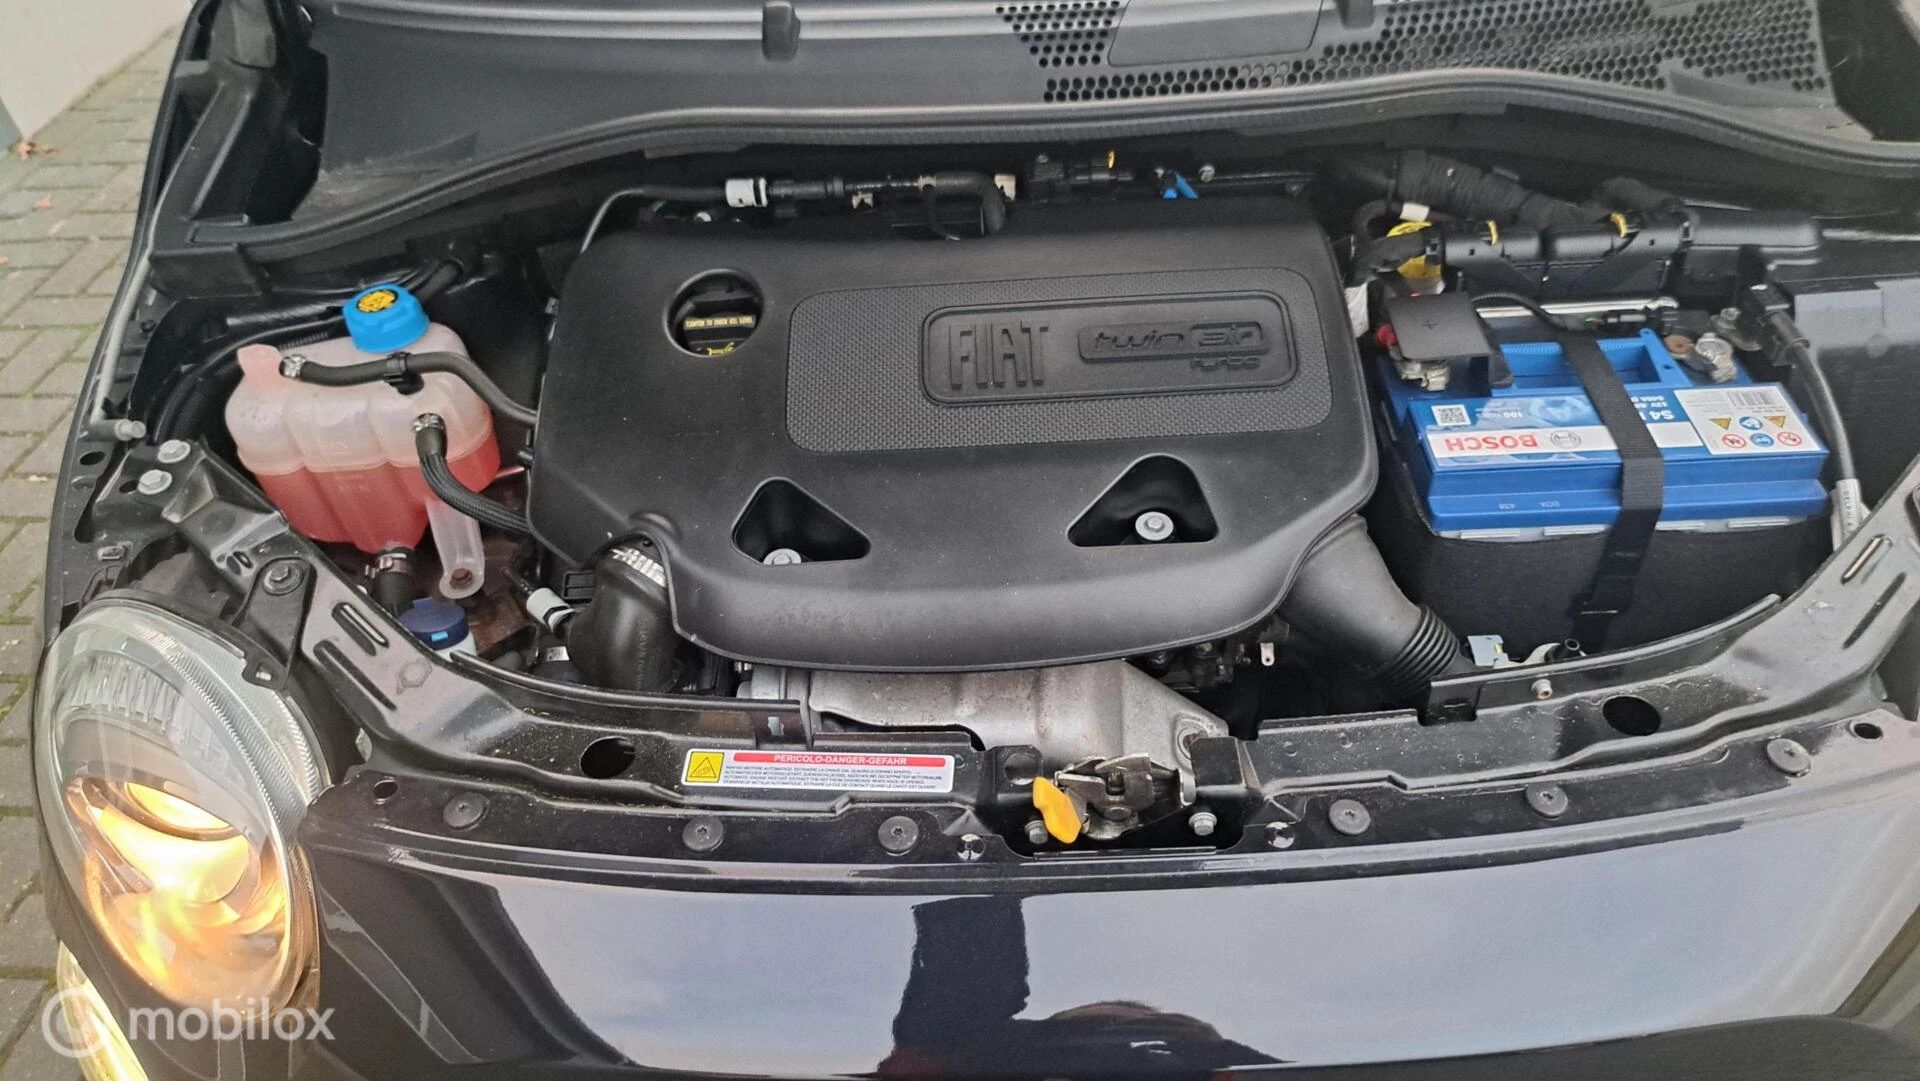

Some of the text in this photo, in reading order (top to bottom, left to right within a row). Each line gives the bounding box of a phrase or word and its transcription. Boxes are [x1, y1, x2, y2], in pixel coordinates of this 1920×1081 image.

[948, 317, 1049, 389] FIAT
[1444, 434, 1539, 452] BOSCH
[774, 754, 908, 765] PERICOLO-DANGER-GEFAHR
